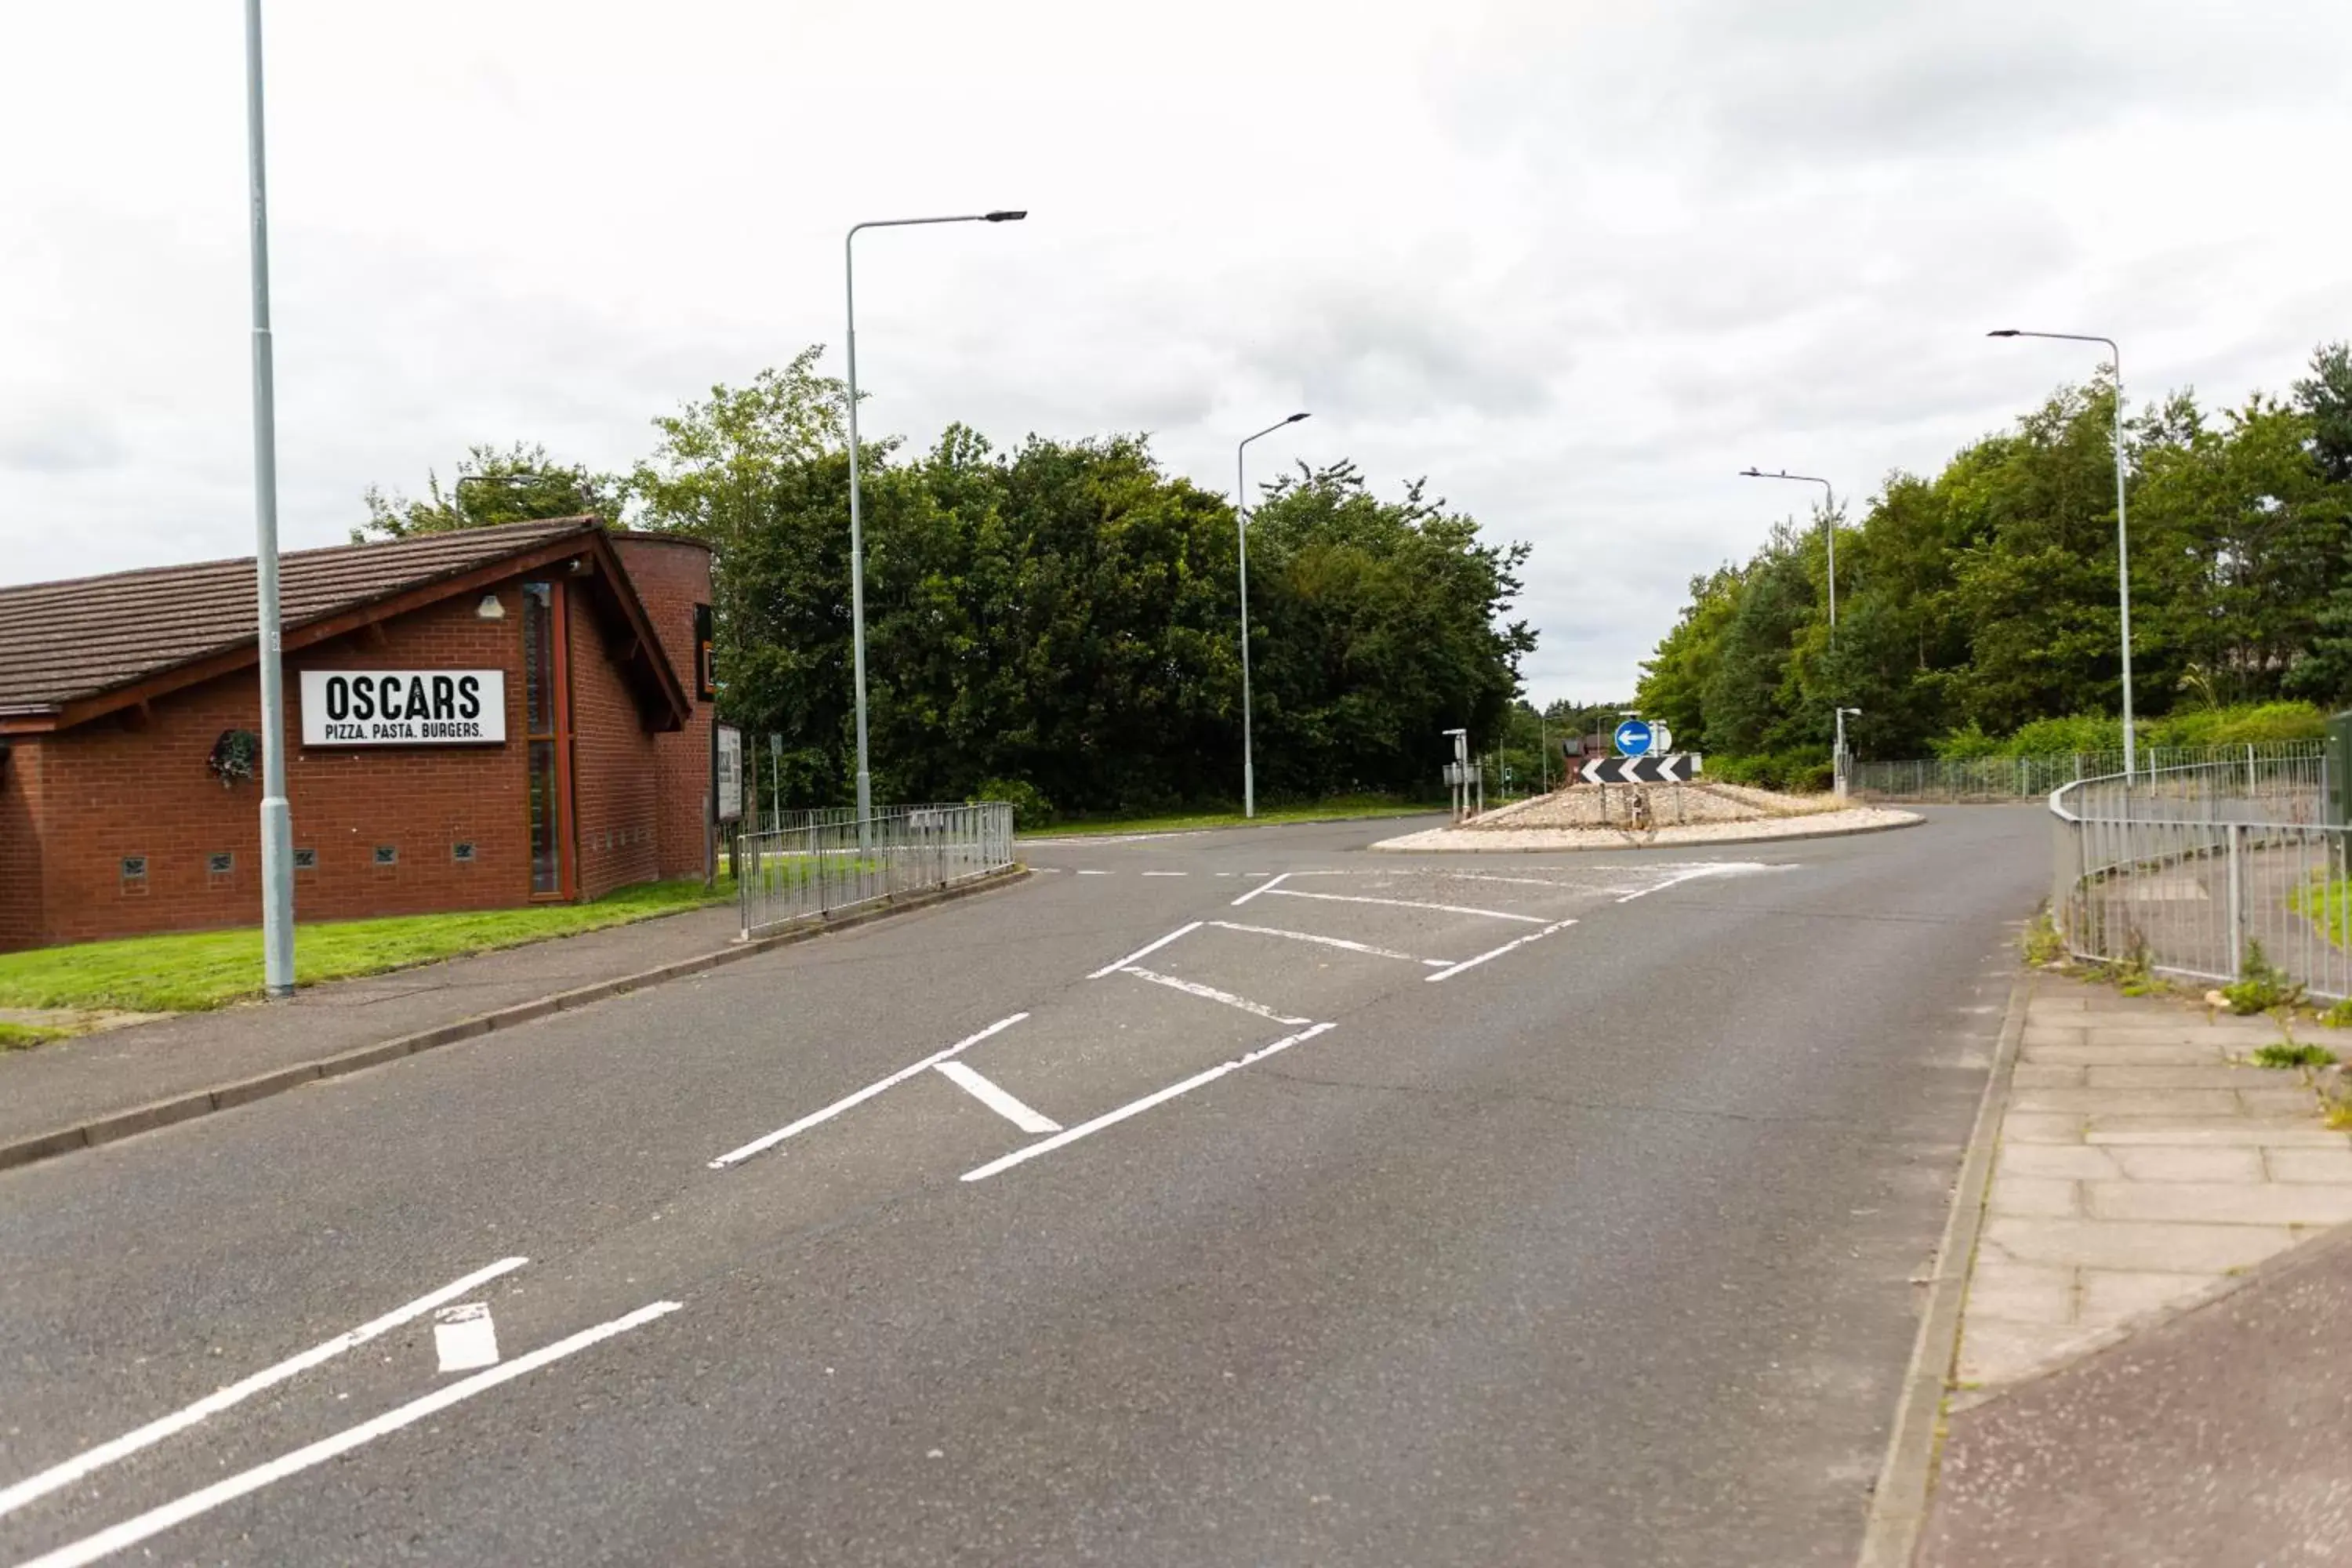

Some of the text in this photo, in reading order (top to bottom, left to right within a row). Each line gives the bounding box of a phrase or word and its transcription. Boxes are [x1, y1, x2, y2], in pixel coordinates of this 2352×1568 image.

[326, 675, 481, 720] OSCARS
[325, 722, 483, 739] PIZZA. PASTA. BURGERS.
